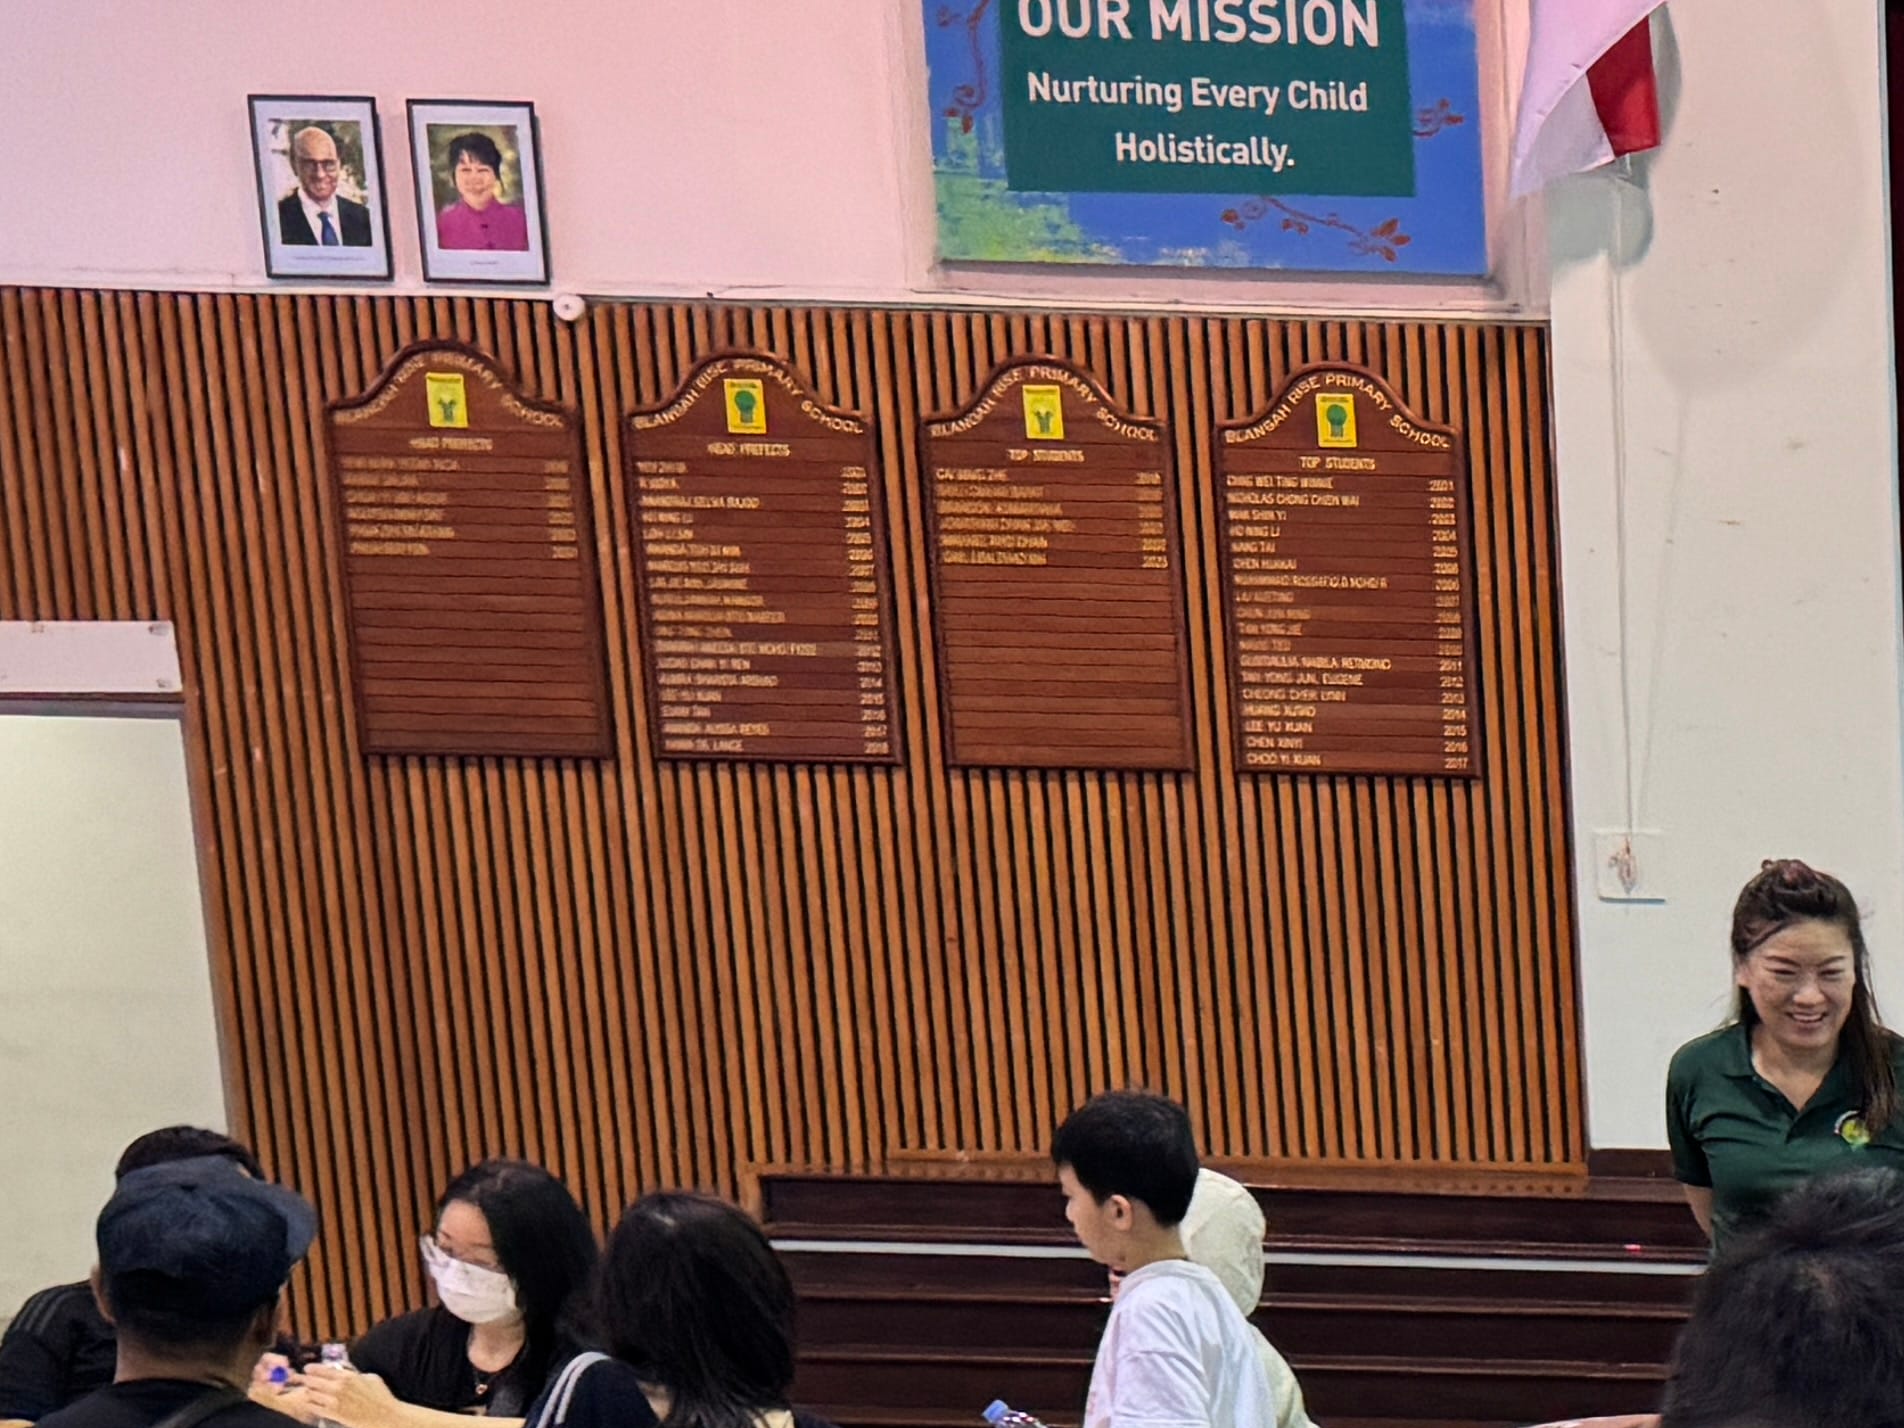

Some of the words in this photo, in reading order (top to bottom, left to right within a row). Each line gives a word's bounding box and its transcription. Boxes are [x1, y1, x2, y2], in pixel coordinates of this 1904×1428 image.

[1018, 0, 1133, 40] OUR
[1151, 0, 1379, 48] MISSION
[1028, 71, 1182, 113] Nurturing
[1191, 77, 1280, 116] Every
[1288, 80, 1368, 113] Child
[1115, 132, 1295, 173] Holistically.
[1288, 375, 1321, 406] RISE
[1326, 373, 1392, 411] PRIMARY
[1389, 414, 1450, 448] SCHOOL
[1300, 456, 1320, 469] TOP
[1326, 457, 1375, 470] STUDENTS
